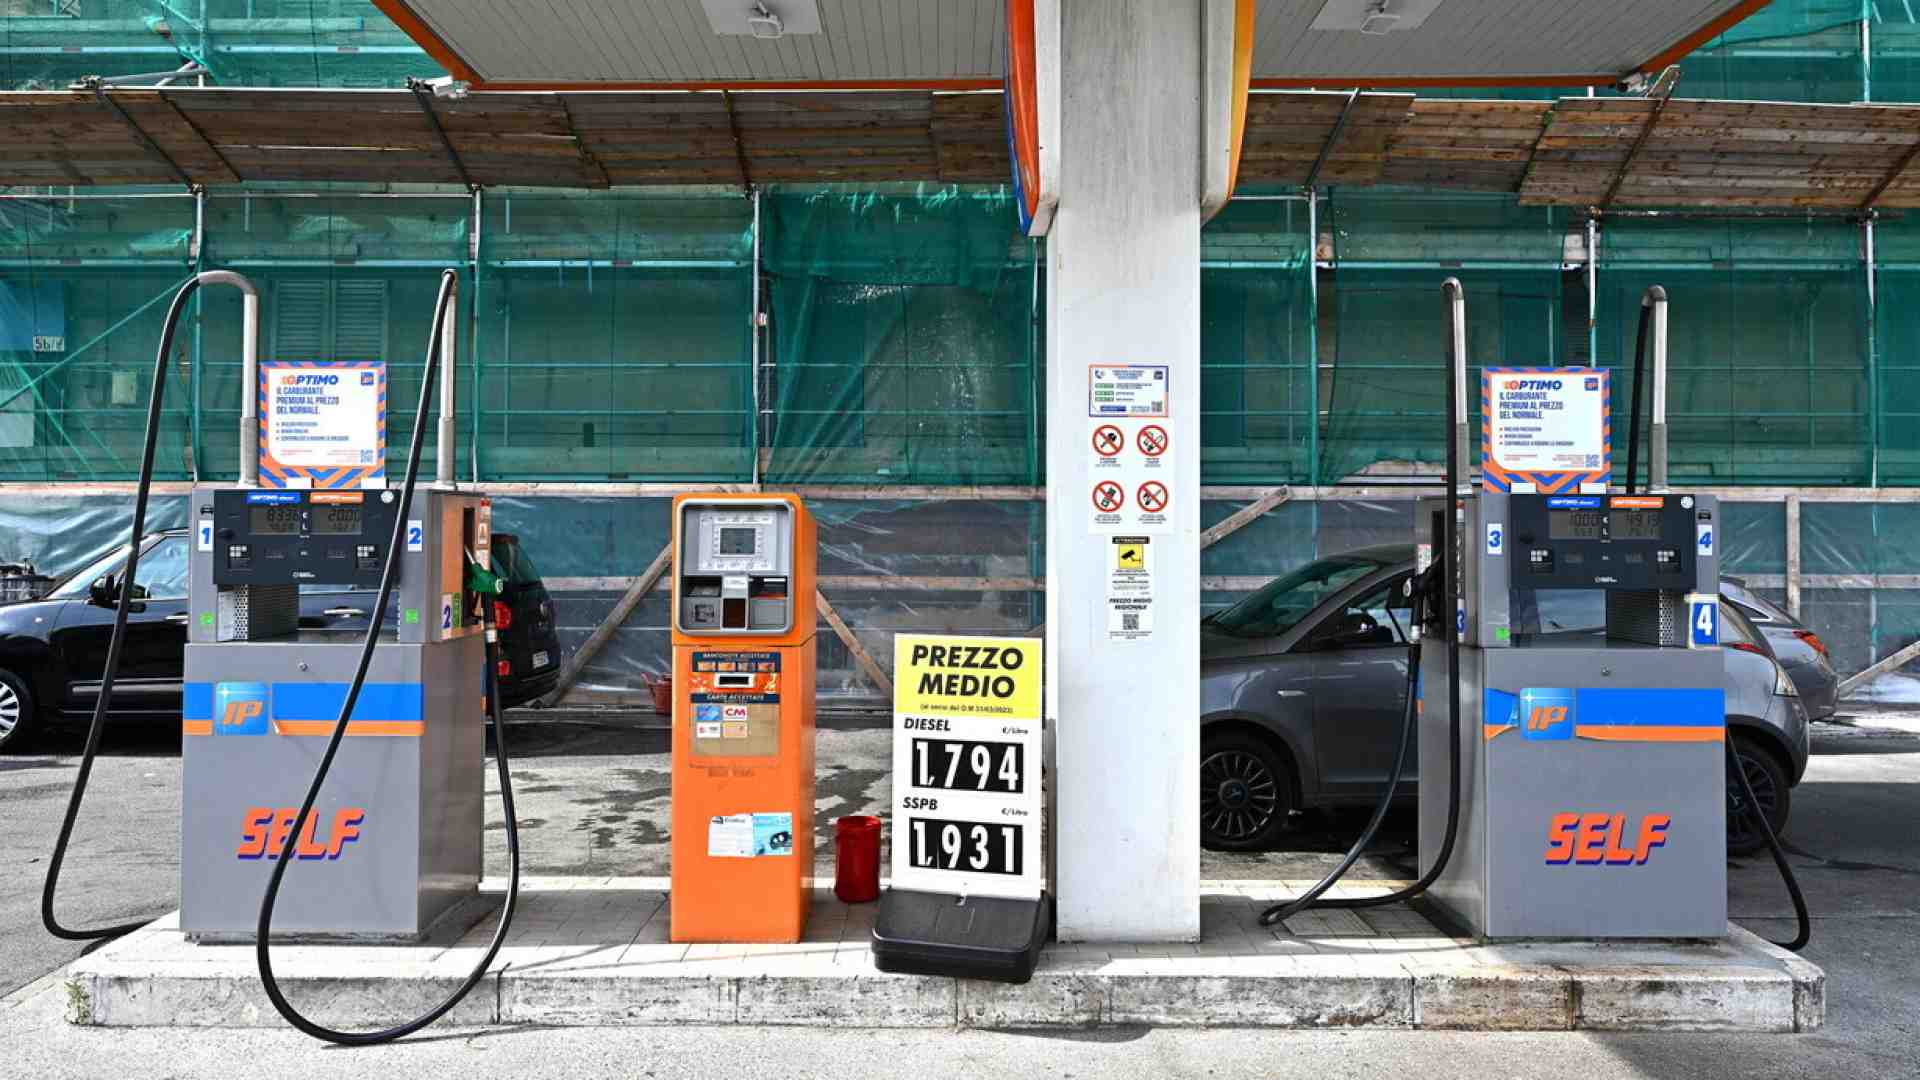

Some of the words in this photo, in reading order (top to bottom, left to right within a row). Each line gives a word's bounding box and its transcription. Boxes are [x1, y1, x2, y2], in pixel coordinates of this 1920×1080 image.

[1499, 411, 1511, 419] DEL
[1539, 401, 1564, 410] PREZZO
[201, 527, 211, 545] 1
[409, 527, 422, 545] 2
[1488, 530, 1502, 548] 3
[1699, 532, 1712, 548] 4
[443, 605, 451, 629] 2
[1697, 604, 1713, 637] 4
[911, 644, 1024, 670] PREZZO
[917, 673, 1015, 698] MEDIO
[222, 701, 263, 726] IP
[725, 708, 746, 717] CM
[904, 717, 951, 732] DIESEL
[1527, 706, 1569, 731] IP
[916, 741, 1018, 790] 1,794
[903, 796, 938, 811] SSPB
[237, 806, 365, 860] SELF
[1544, 812, 1671, 865] SELF
[913, 821, 1015, 873] 1,931
